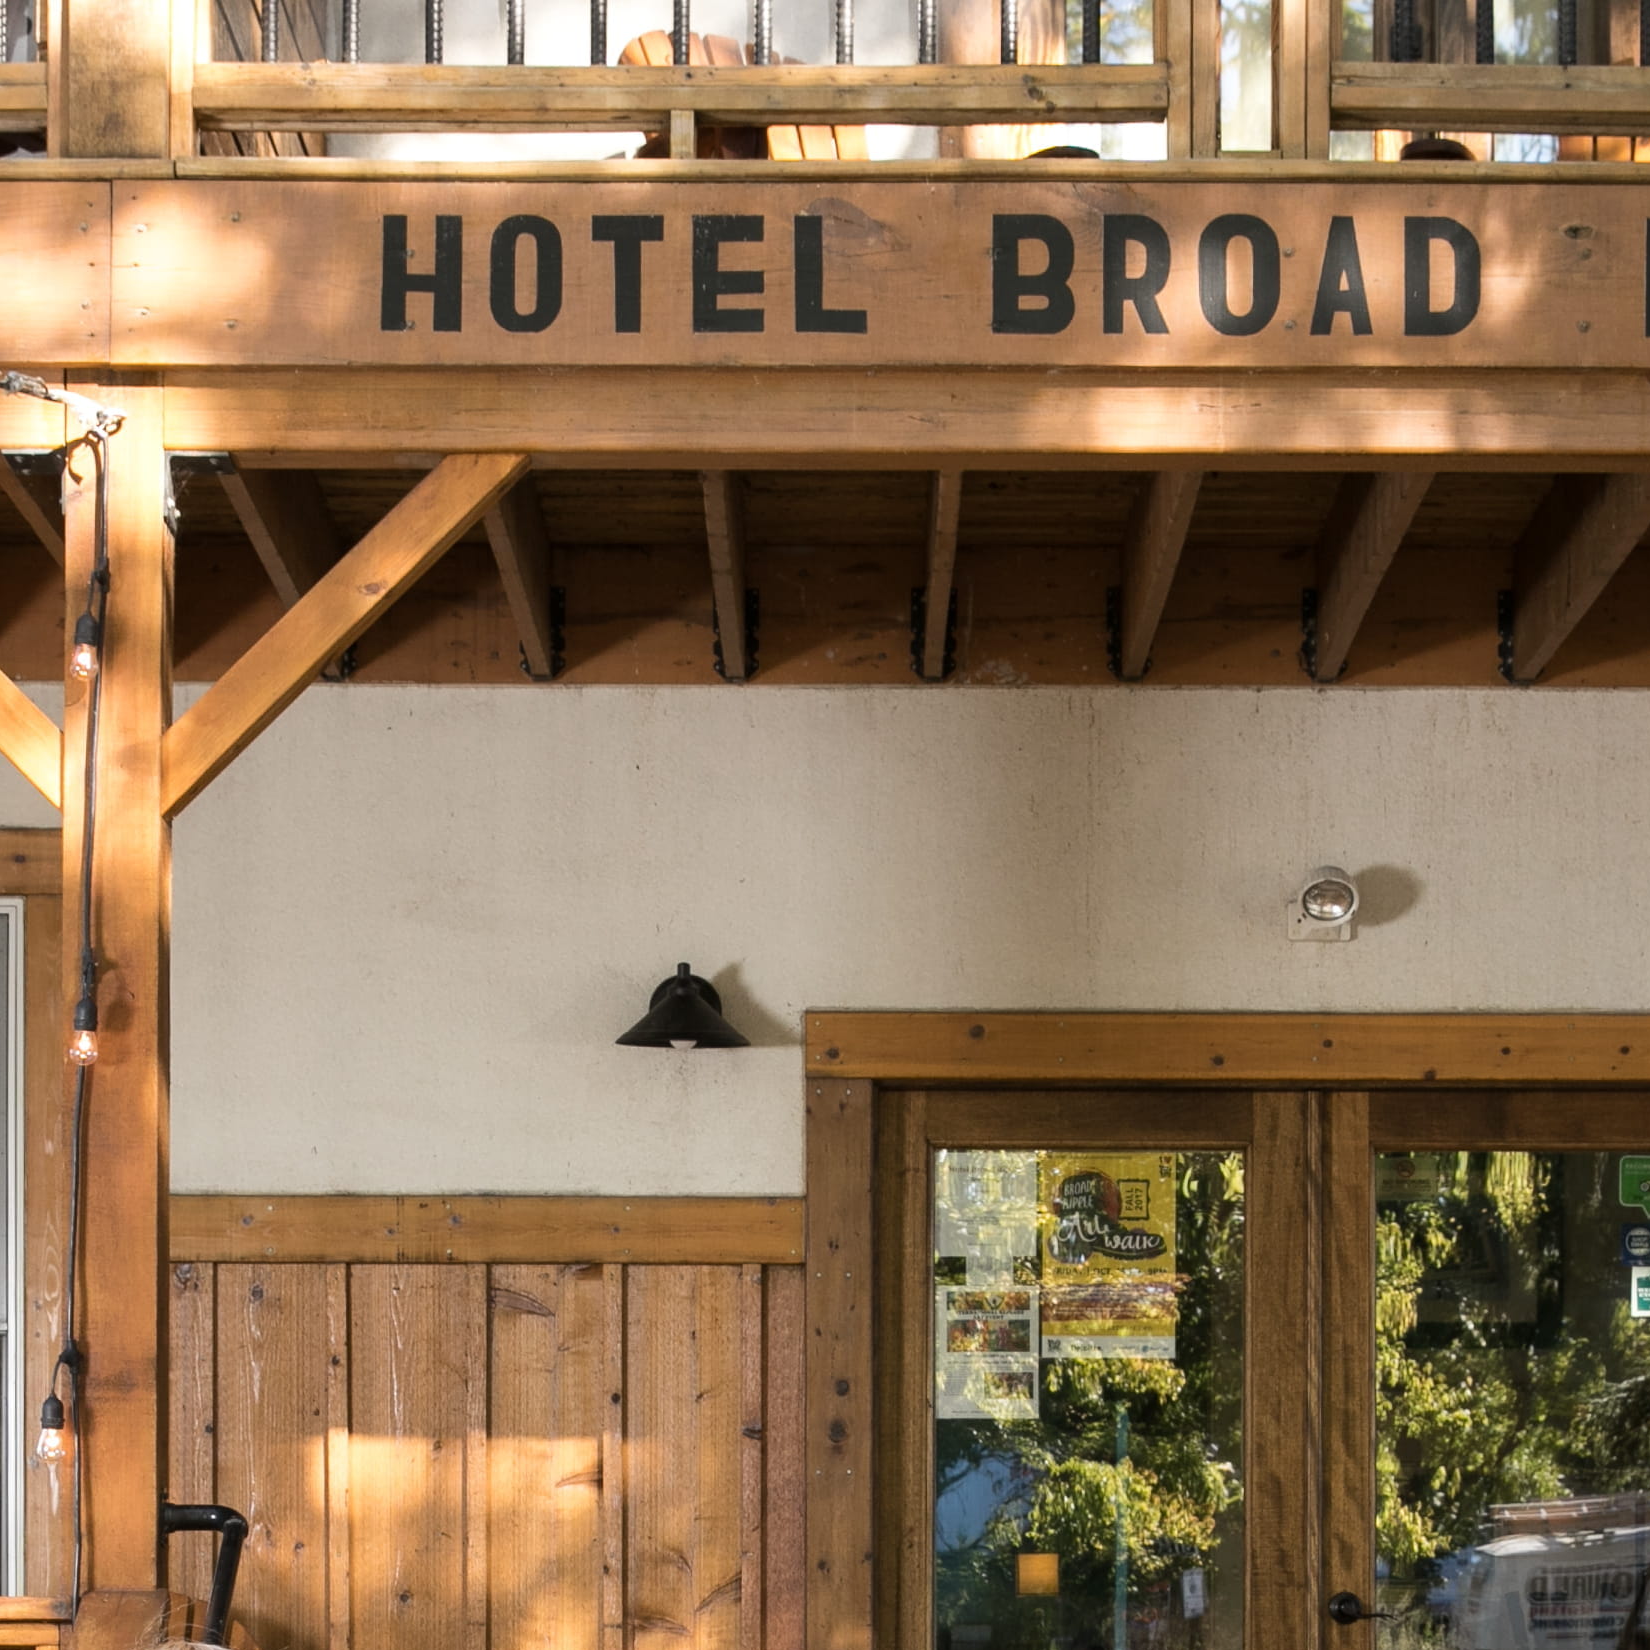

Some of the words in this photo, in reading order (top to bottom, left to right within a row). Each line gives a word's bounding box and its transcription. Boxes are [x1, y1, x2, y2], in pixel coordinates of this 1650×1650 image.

[380, 214, 868, 334] HOTEL
[991, 213, 1481, 336] BROAD
[1064, 1180, 1095, 1196] BROAD
[1125, 1188, 1133, 1211] FALL
[1135, 1188, 1144, 1211] 2017
